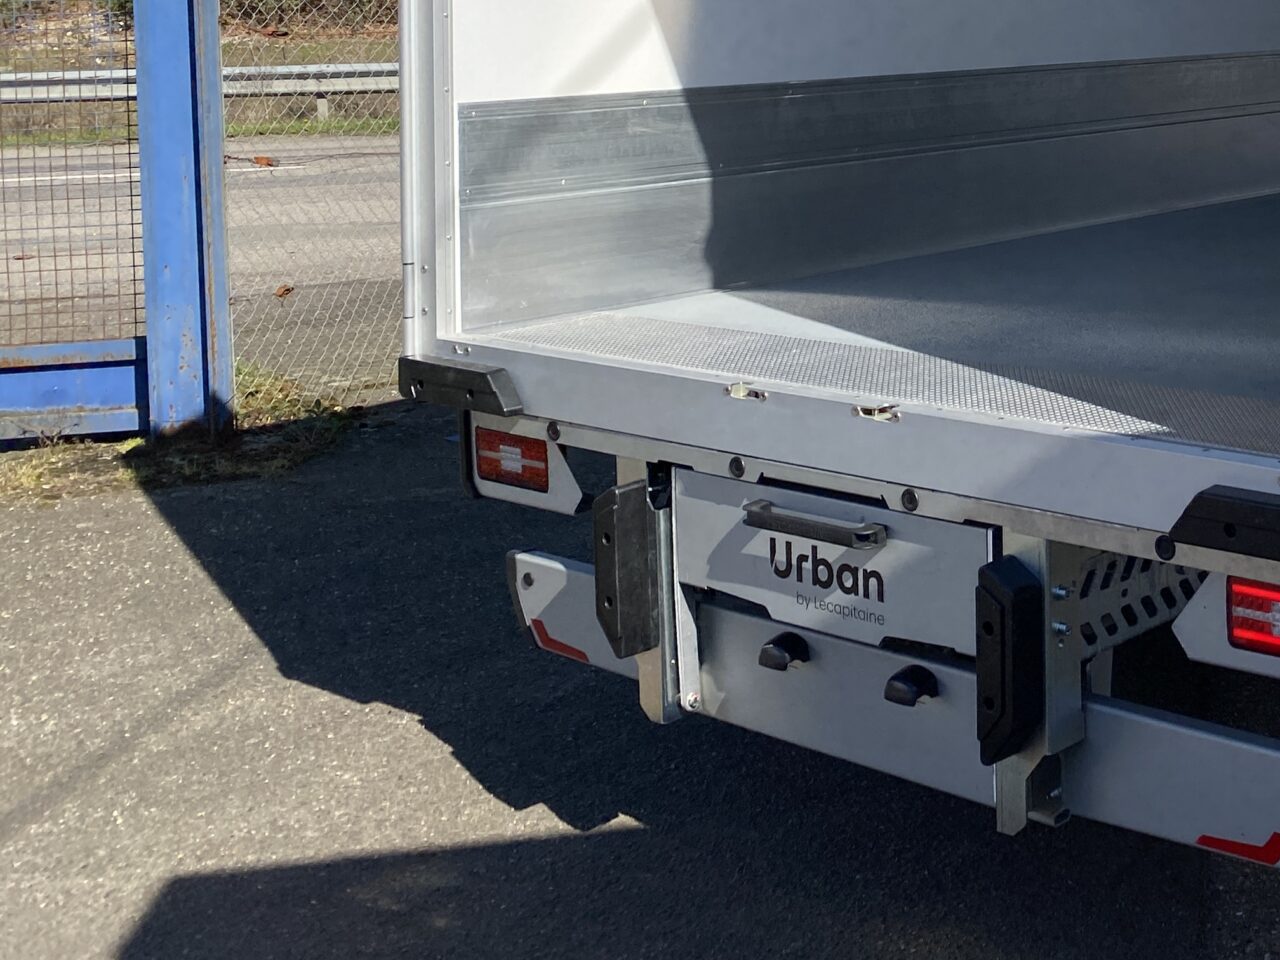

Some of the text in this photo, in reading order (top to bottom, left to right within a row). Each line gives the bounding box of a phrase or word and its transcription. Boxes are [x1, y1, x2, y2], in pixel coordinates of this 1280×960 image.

[769, 537, 885, 604] Urban
[796, 592, 885, 626] by Lecapitaine
